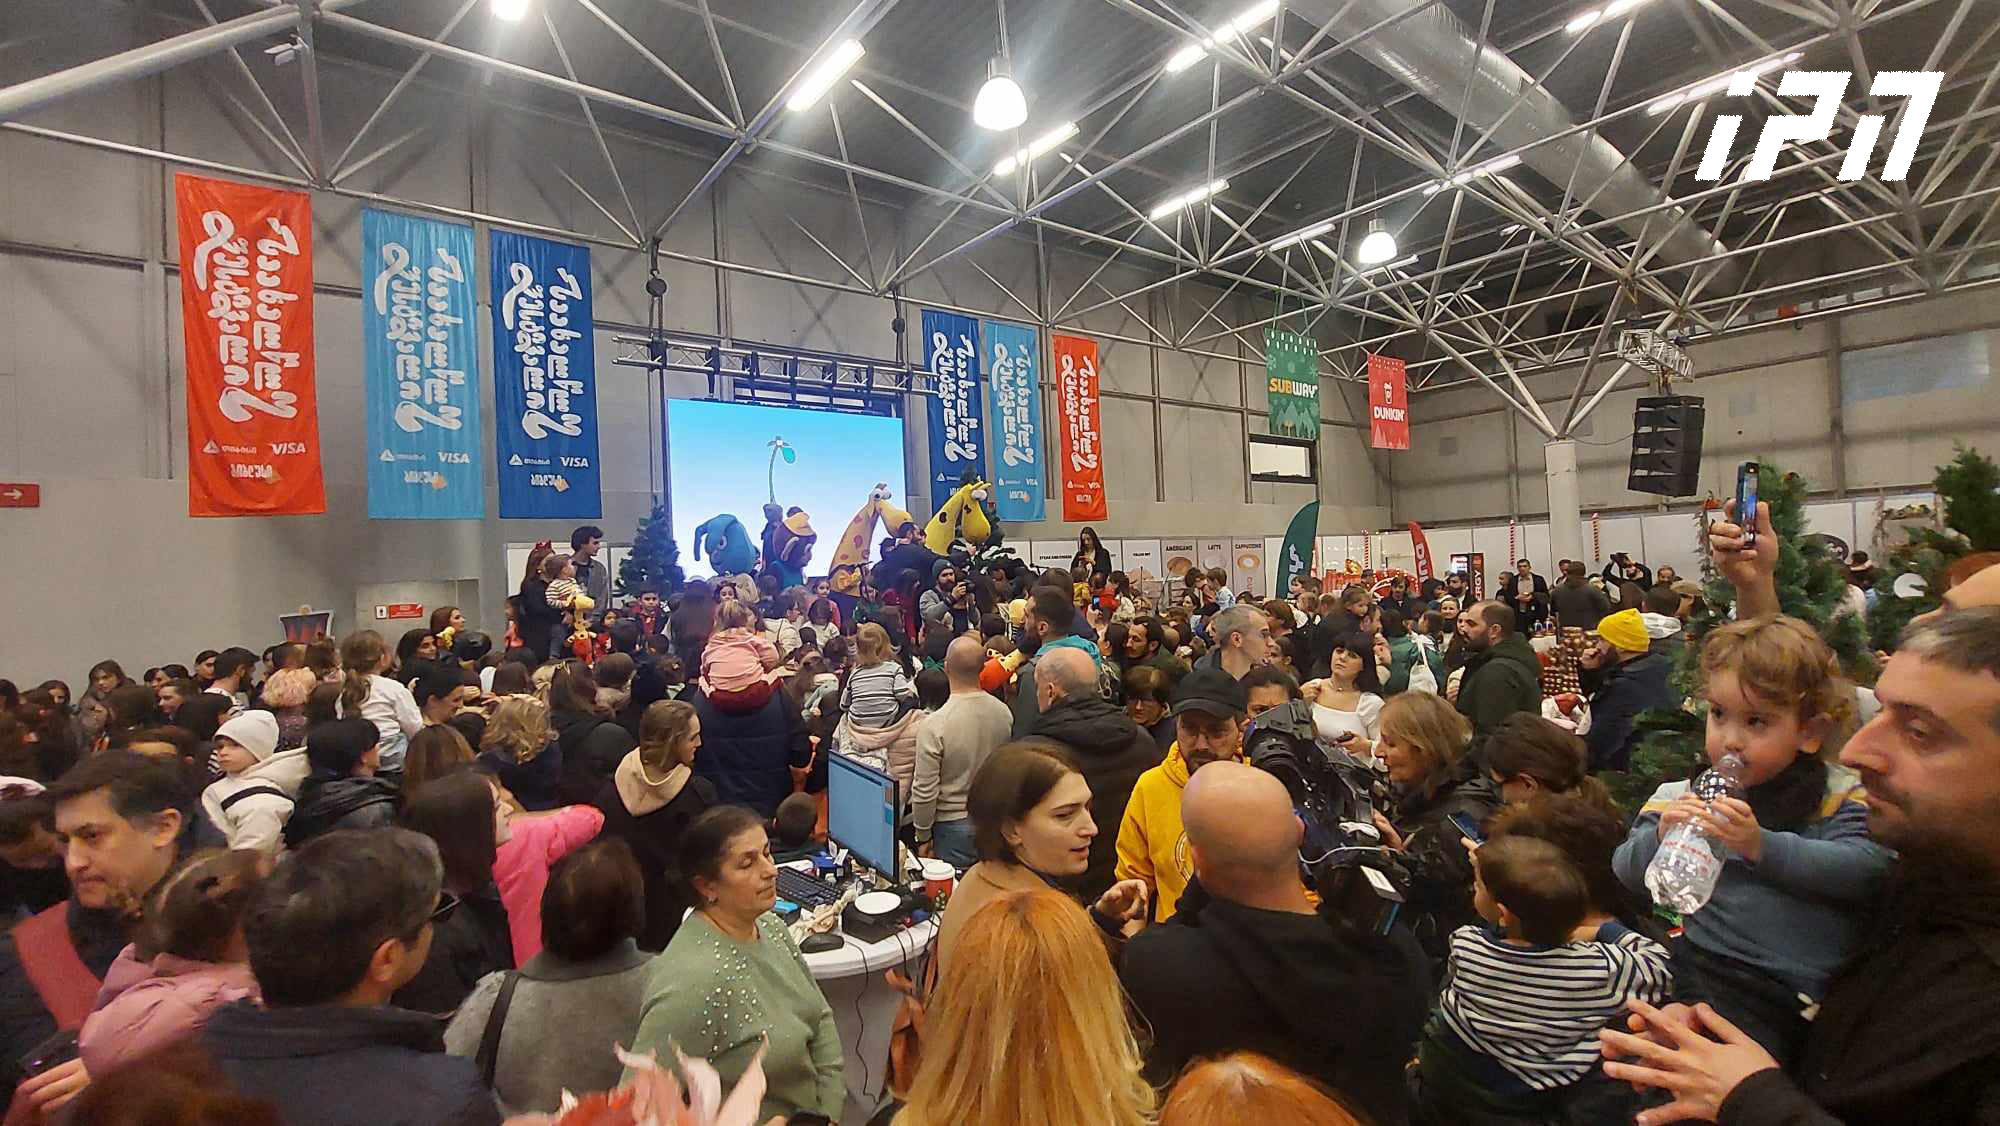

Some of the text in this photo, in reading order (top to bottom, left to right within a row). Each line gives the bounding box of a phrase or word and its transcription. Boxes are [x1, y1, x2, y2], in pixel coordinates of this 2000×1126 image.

[1269, 378, 1317, 398] SUBWAY
[271, 442, 306, 455] VISA
[437, 451, 470, 464] VISA
[560, 456, 589, 467] VISA
